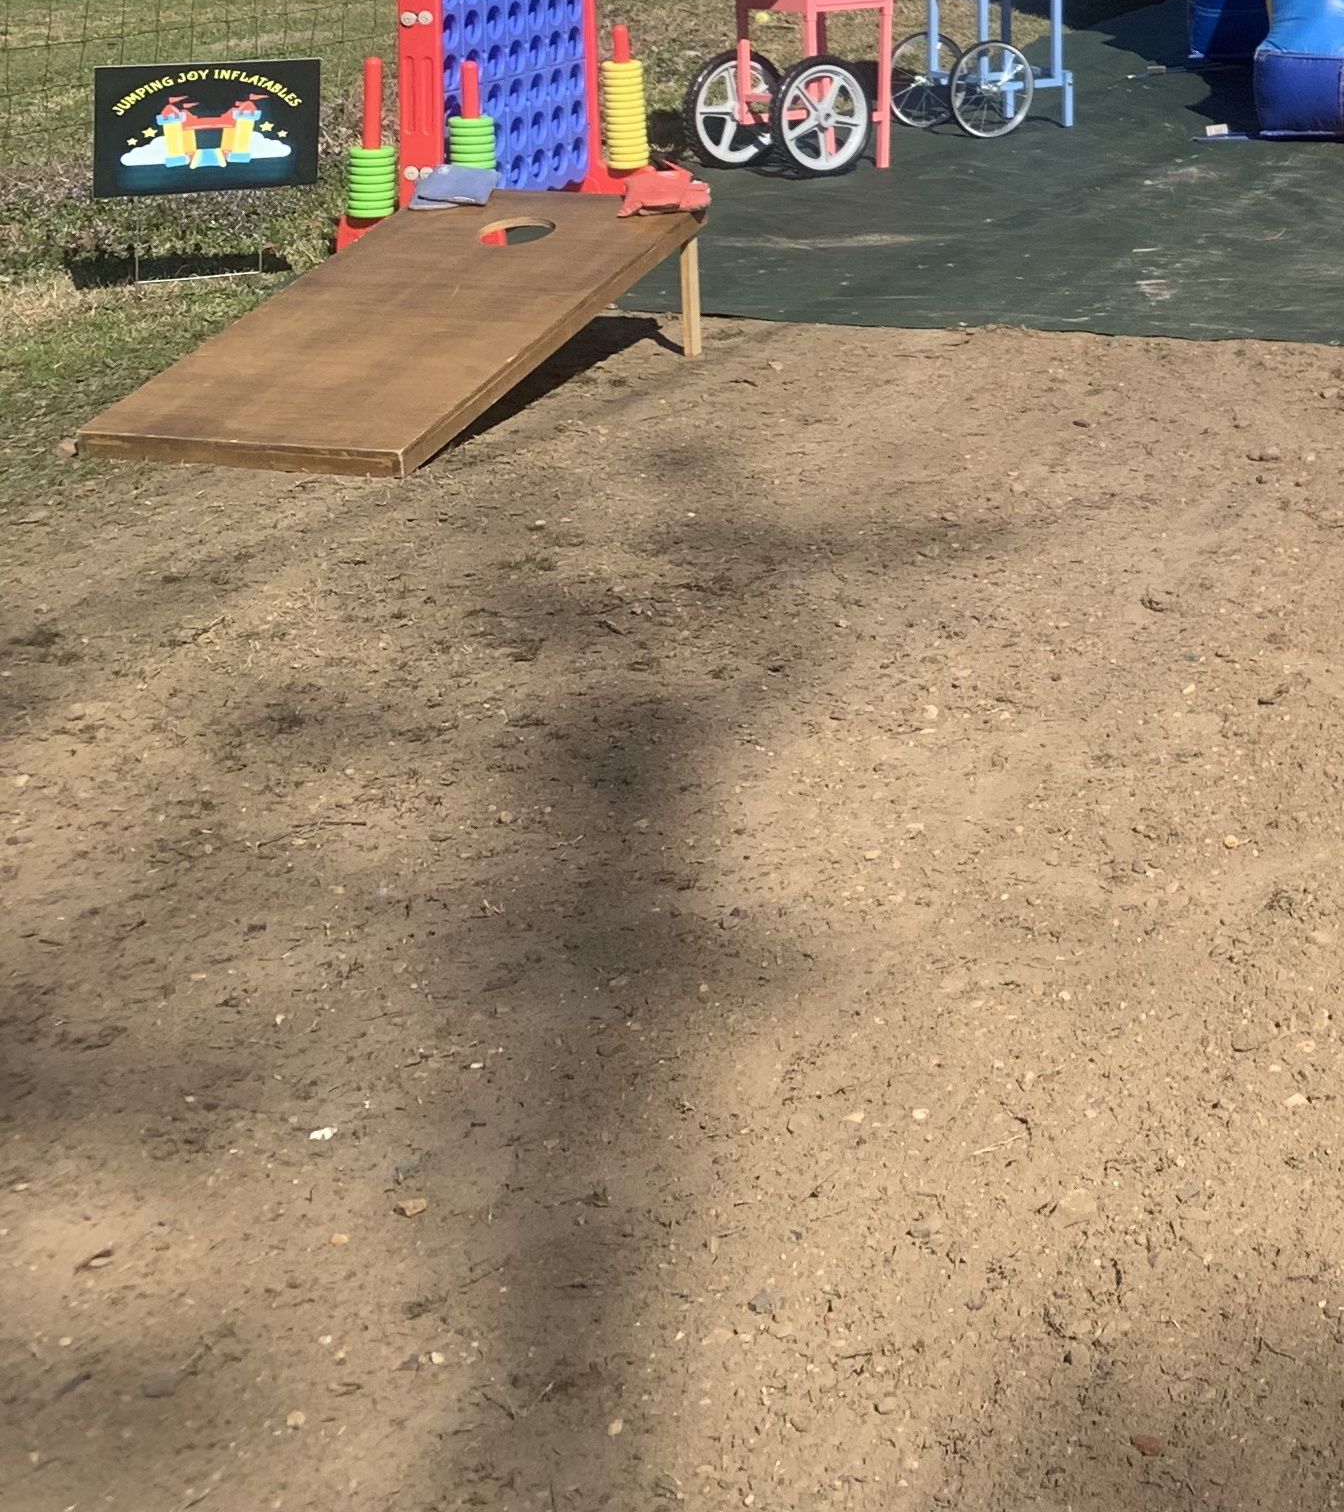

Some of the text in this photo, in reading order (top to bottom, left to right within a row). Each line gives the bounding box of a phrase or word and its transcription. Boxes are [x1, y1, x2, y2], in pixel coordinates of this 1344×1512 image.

[112, 69, 304, 116] JUMPING JOY INFLATABLES
